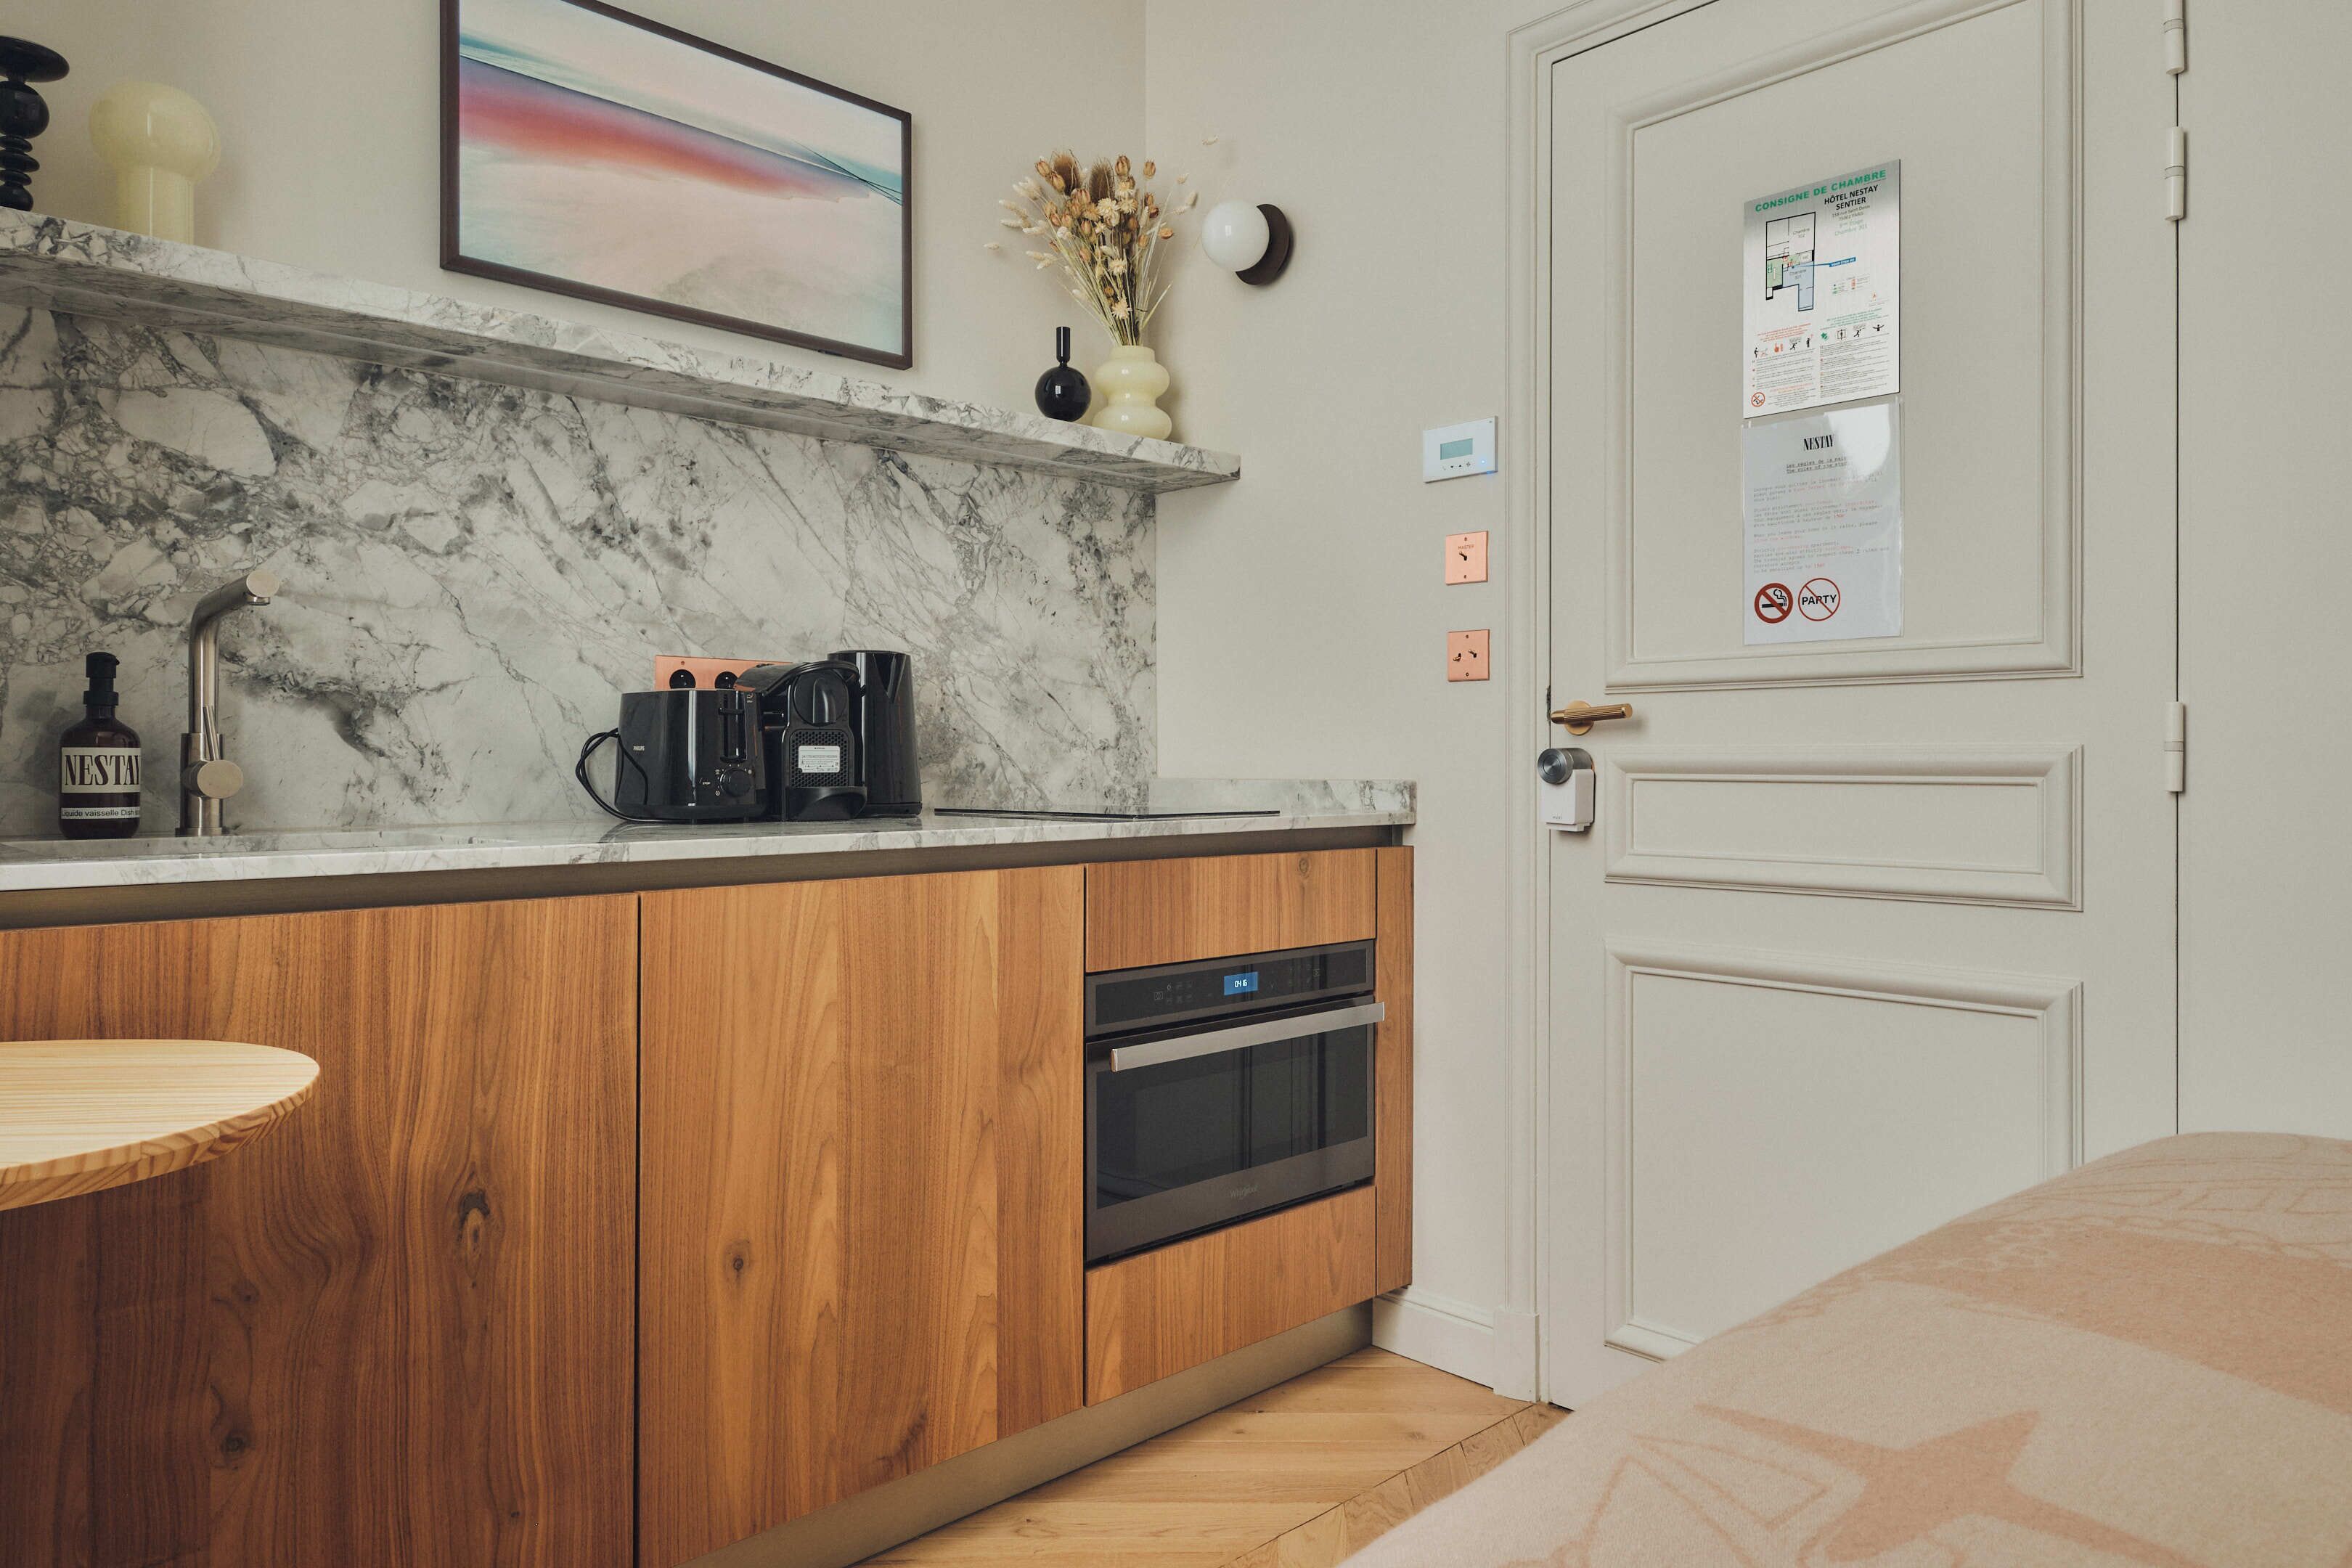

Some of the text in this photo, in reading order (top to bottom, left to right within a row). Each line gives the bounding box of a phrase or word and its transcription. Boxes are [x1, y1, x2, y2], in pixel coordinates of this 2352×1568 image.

[1755, 169, 1887, 212] CONSIGNE DE CHAMBRE
[1824, 184, 1878, 205] HÔTEL NESTAY
[1836, 197, 1866, 211] SENTIER
[1803, 434, 1834, 451] NESTAY
[1802, 594, 1837, 605] PARTY
